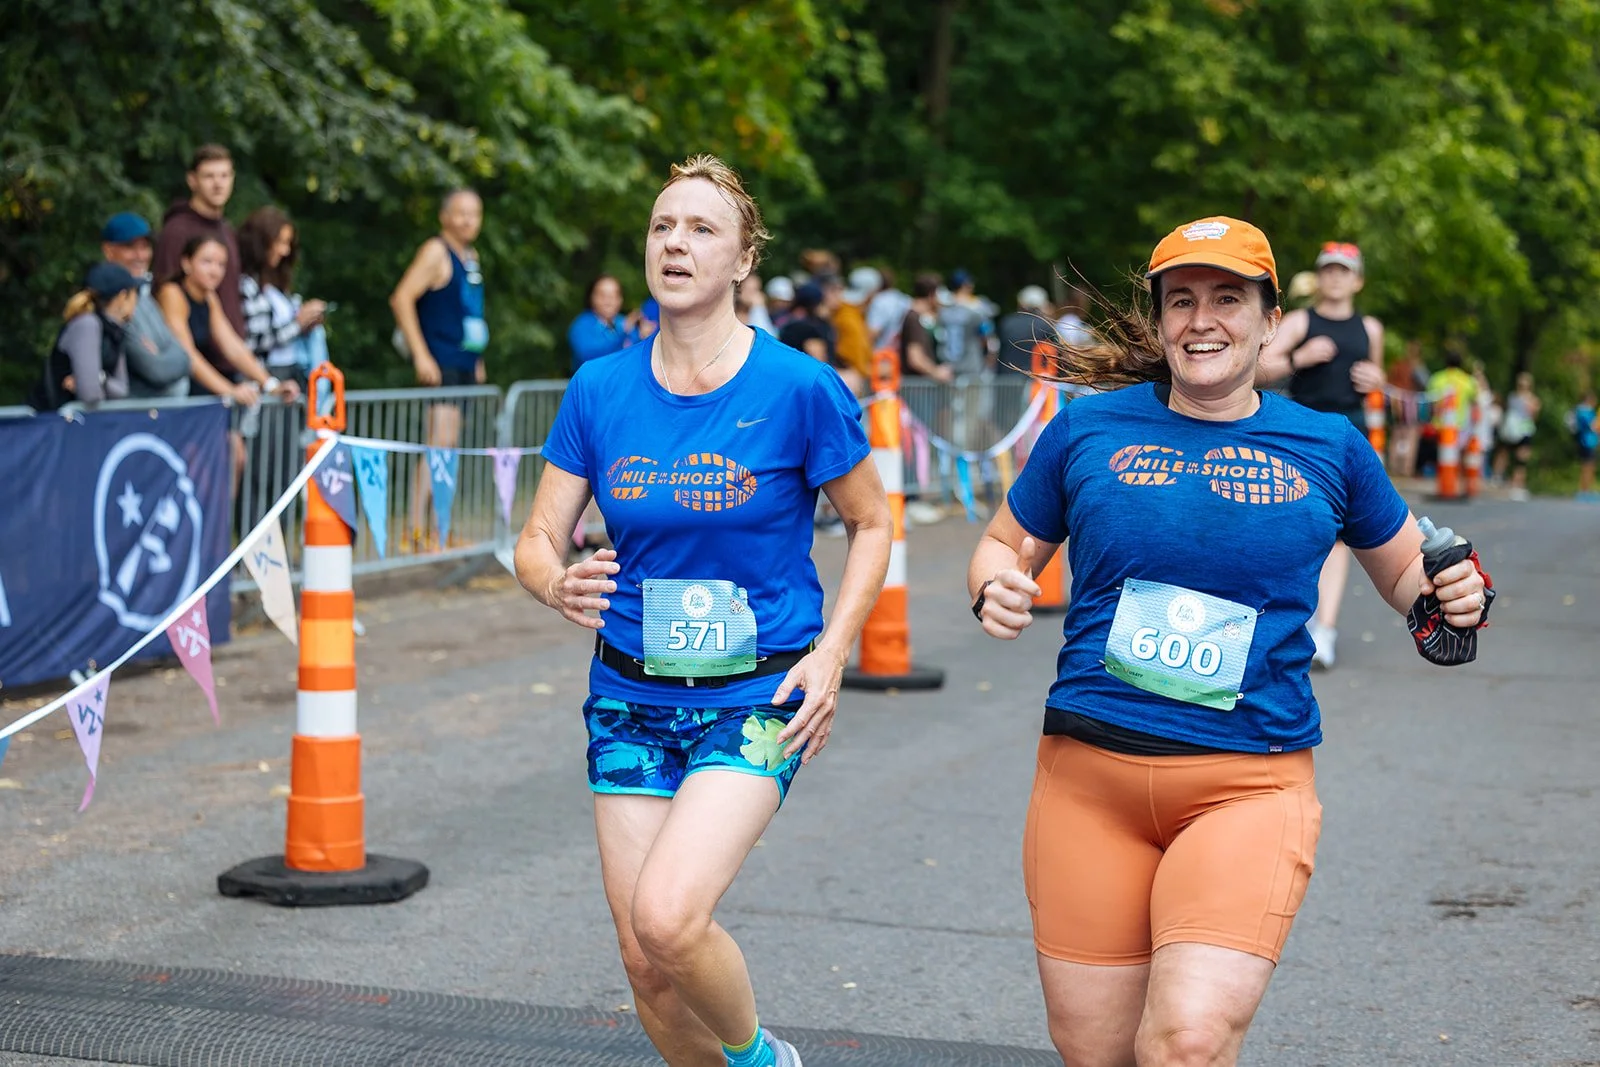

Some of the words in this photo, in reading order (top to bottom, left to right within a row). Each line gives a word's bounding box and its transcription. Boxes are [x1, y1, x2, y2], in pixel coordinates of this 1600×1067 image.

[620, 471, 658, 485] MILE
[668, 472, 725, 485] SHOES
[1133, 457, 1185, 473] MILE
[1201, 463, 1271, 480] SHOES
[666, 619, 727, 651] 571
[1130, 626, 1223, 677] 600
